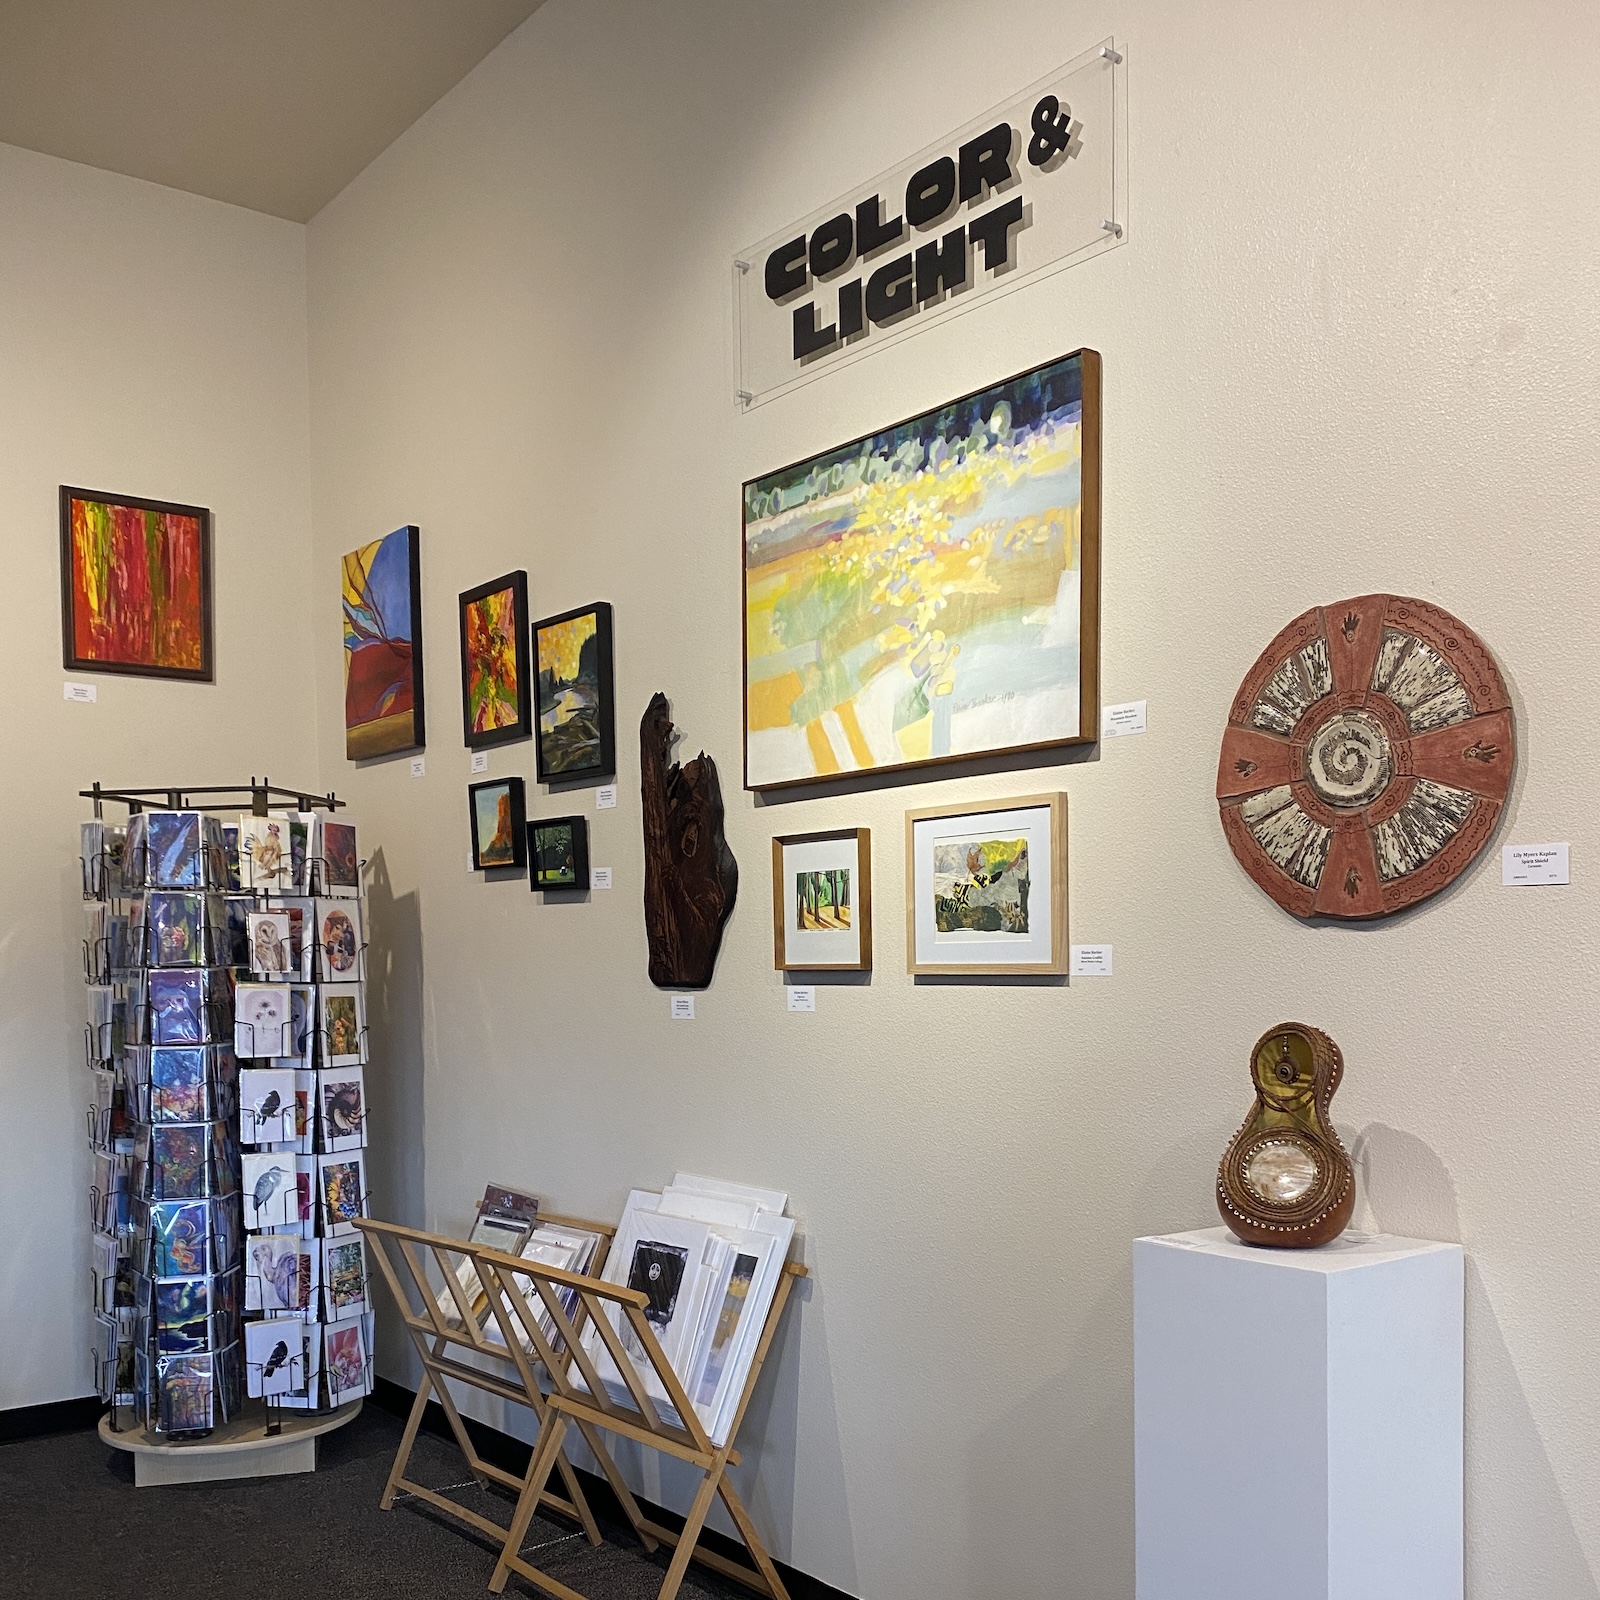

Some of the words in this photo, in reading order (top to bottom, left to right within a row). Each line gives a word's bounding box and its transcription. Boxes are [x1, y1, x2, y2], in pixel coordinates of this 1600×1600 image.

[765, 122, 1012, 300] COLOR
[1028, 94, 1071, 166] &
[793, 195, 1023, 360] LIGHT
